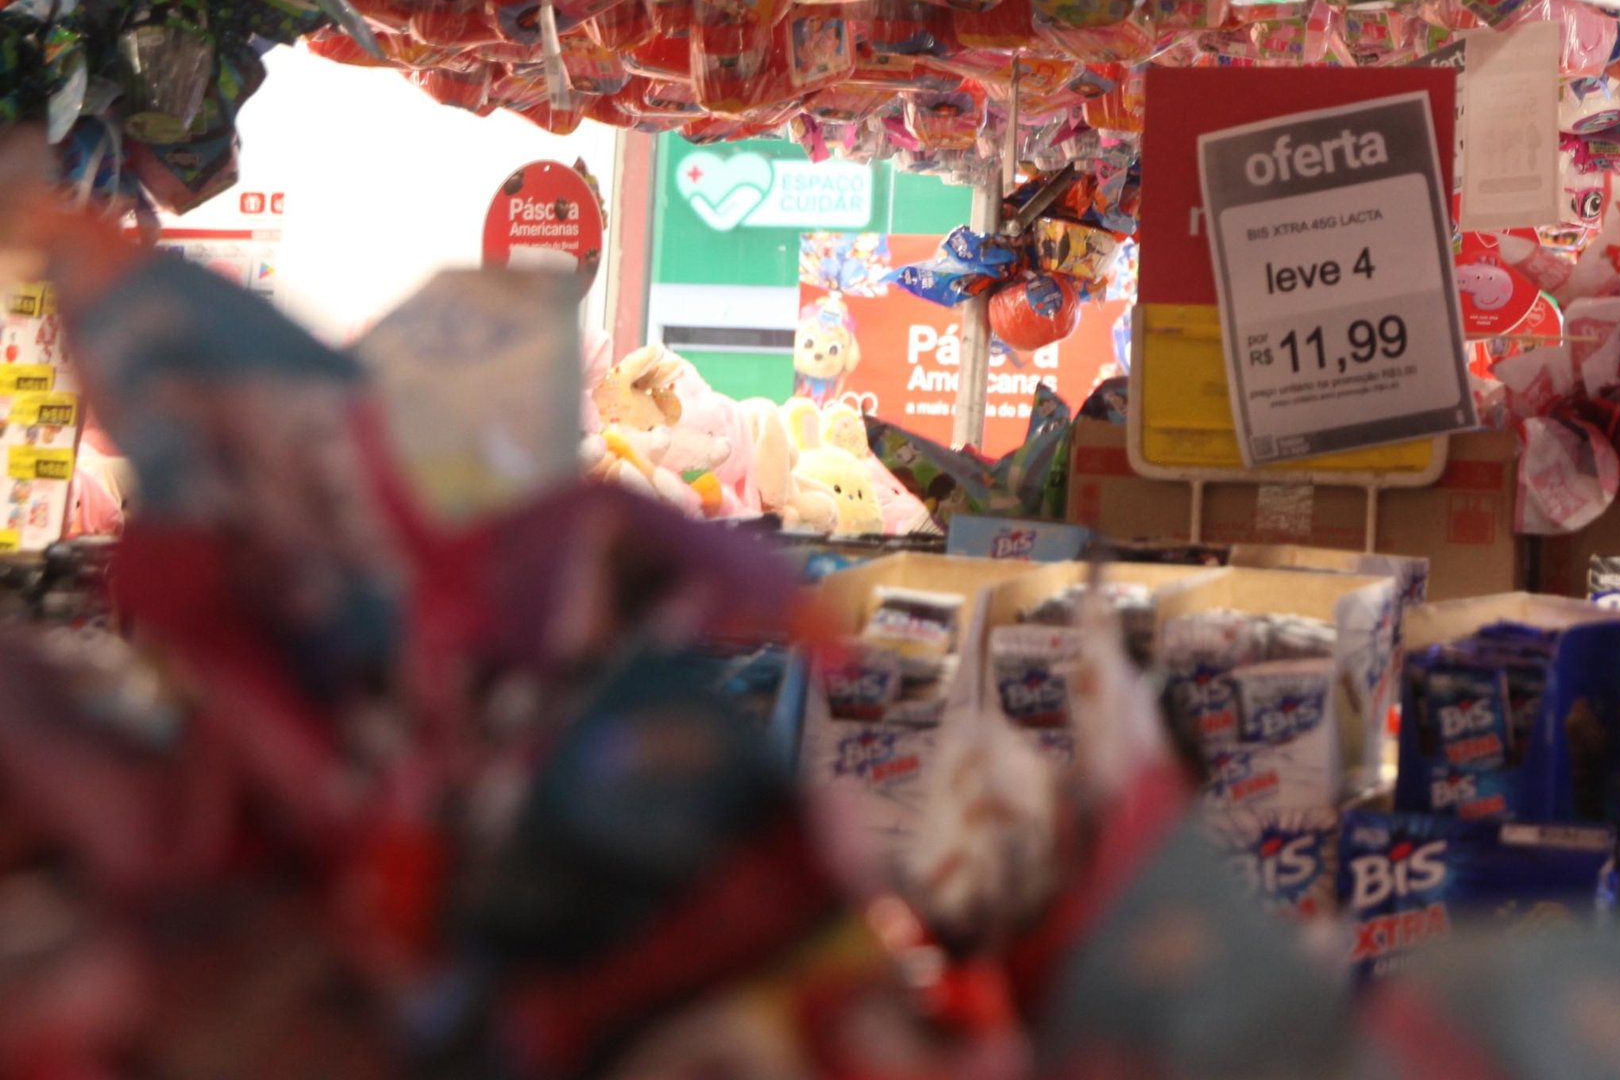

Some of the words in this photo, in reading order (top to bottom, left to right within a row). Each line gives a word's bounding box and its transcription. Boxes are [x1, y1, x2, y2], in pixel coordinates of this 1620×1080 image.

[1245, 129, 1390, 188] oferta
[781, 174, 864, 193] ESPAÇO
[779, 195, 863, 212] CUIDAR
[508, 222, 580, 237] Americanas
[1246, 225, 1270, 241] BIS
[1273, 220, 1311, 237] XTRA
[1340, 208, 1384, 227] LACTA
[1265, 260, 1342, 296] leve
[1352, 246, 1377, 280] 4
[1249, 348, 1275, 367] R$
[1279, 314, 1409, 375] 11,99
[917, 400, 950, 416] mais
